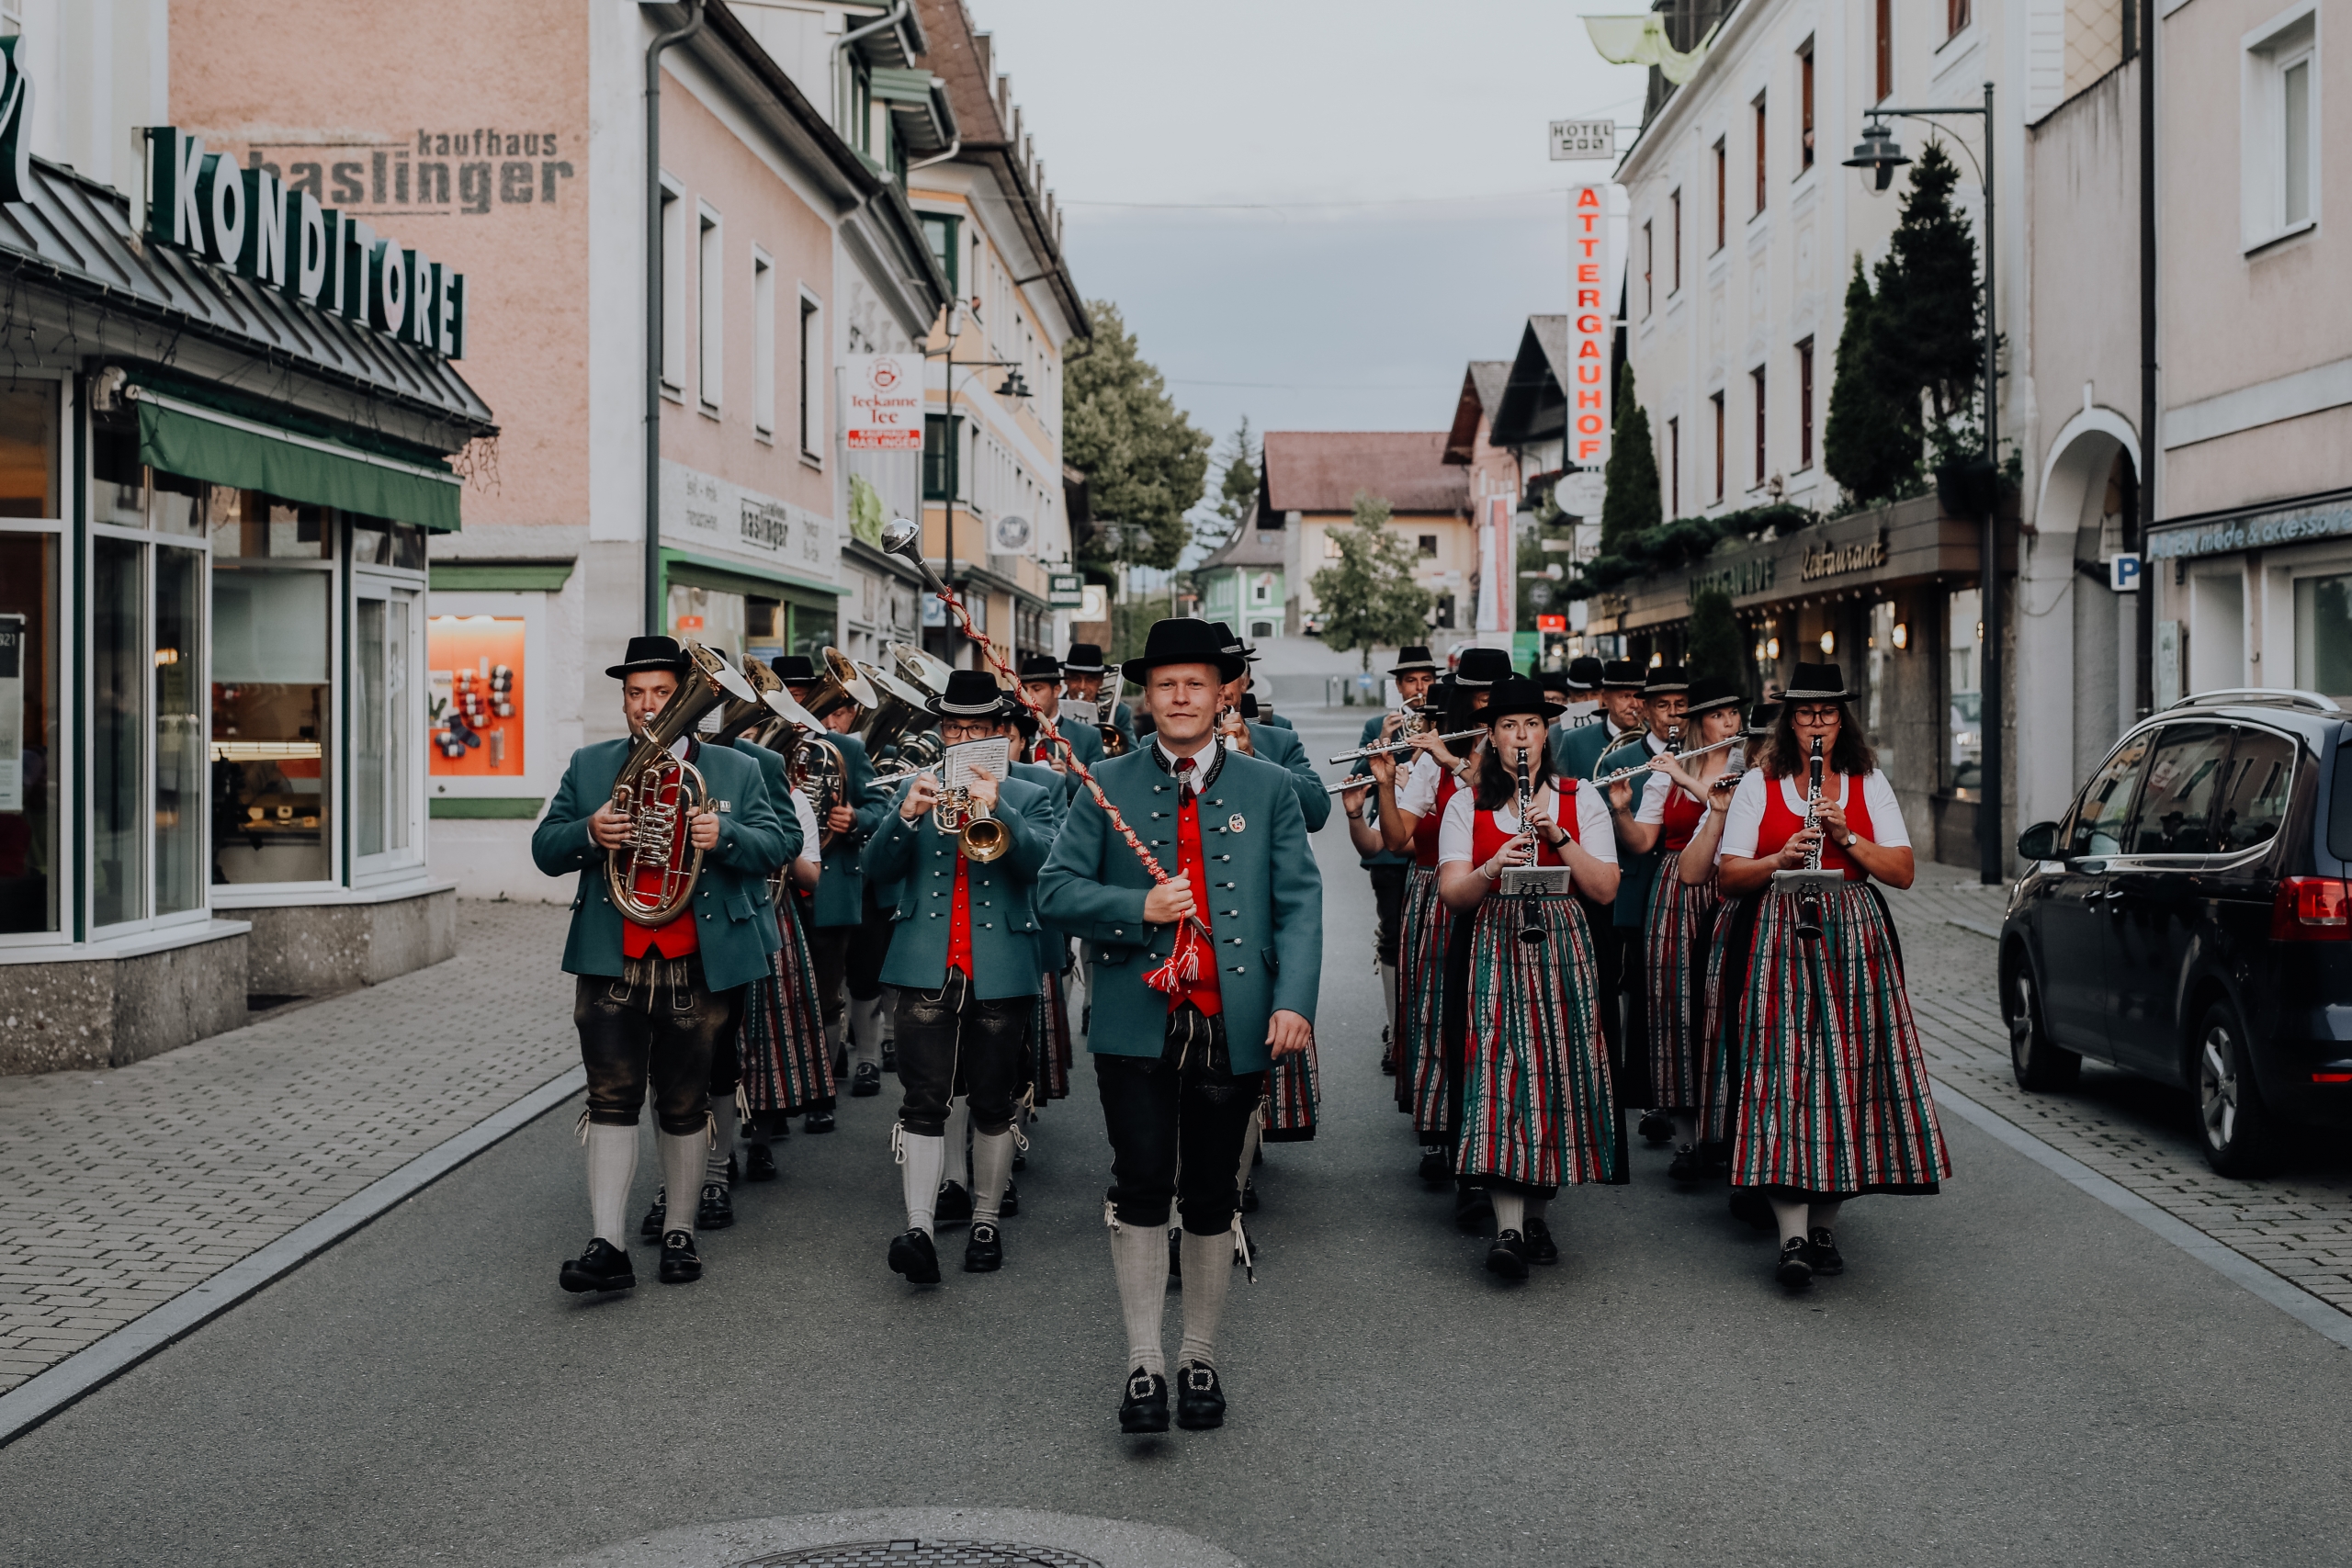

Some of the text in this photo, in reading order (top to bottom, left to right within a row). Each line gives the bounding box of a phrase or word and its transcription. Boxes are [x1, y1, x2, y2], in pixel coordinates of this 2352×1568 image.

[1554, 125, 1611, 137] HOTEL
[417, 128, 559, 157] kaufhaus
[1576, 187, 1603, 460] ATTERGAUHOF
[852, 394, 918, 408] Teekanne
[872, 409, 899, 423] Tee
[849, 437, 921, 448] HASLINGER
[2200, 521, 2245, 551] mode
[2246, 520, 2260, 546] &
[2118, 558, 2141, 585] P
